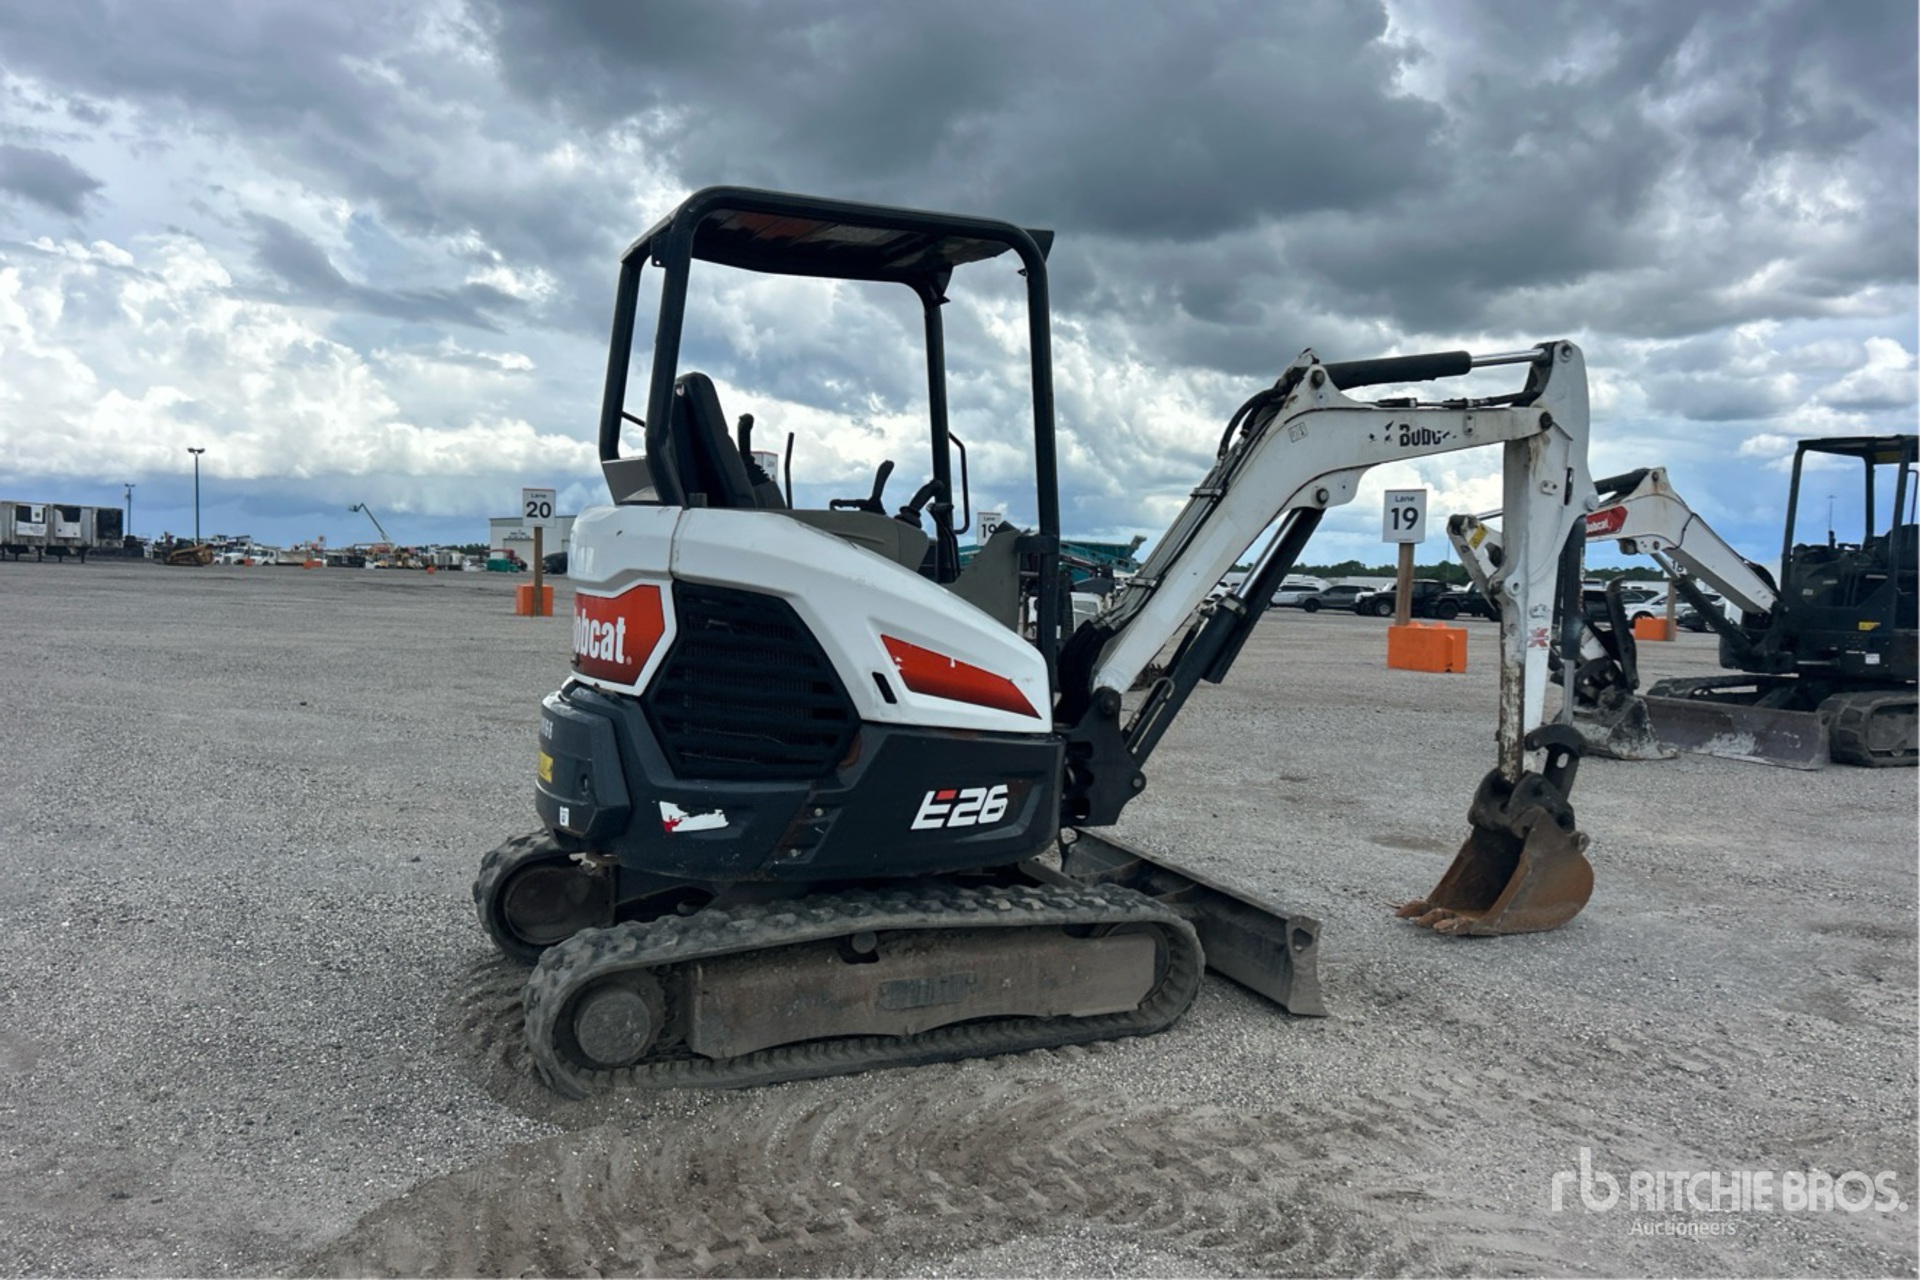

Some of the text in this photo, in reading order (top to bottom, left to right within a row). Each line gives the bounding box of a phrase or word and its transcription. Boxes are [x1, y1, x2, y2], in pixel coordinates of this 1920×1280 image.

[526, 501, 552, 518] 20
[1394, 495, 1416, 503] Lane
[1390, 506, 1419, 531] 19
[910, 784, 1009, 830] E26
